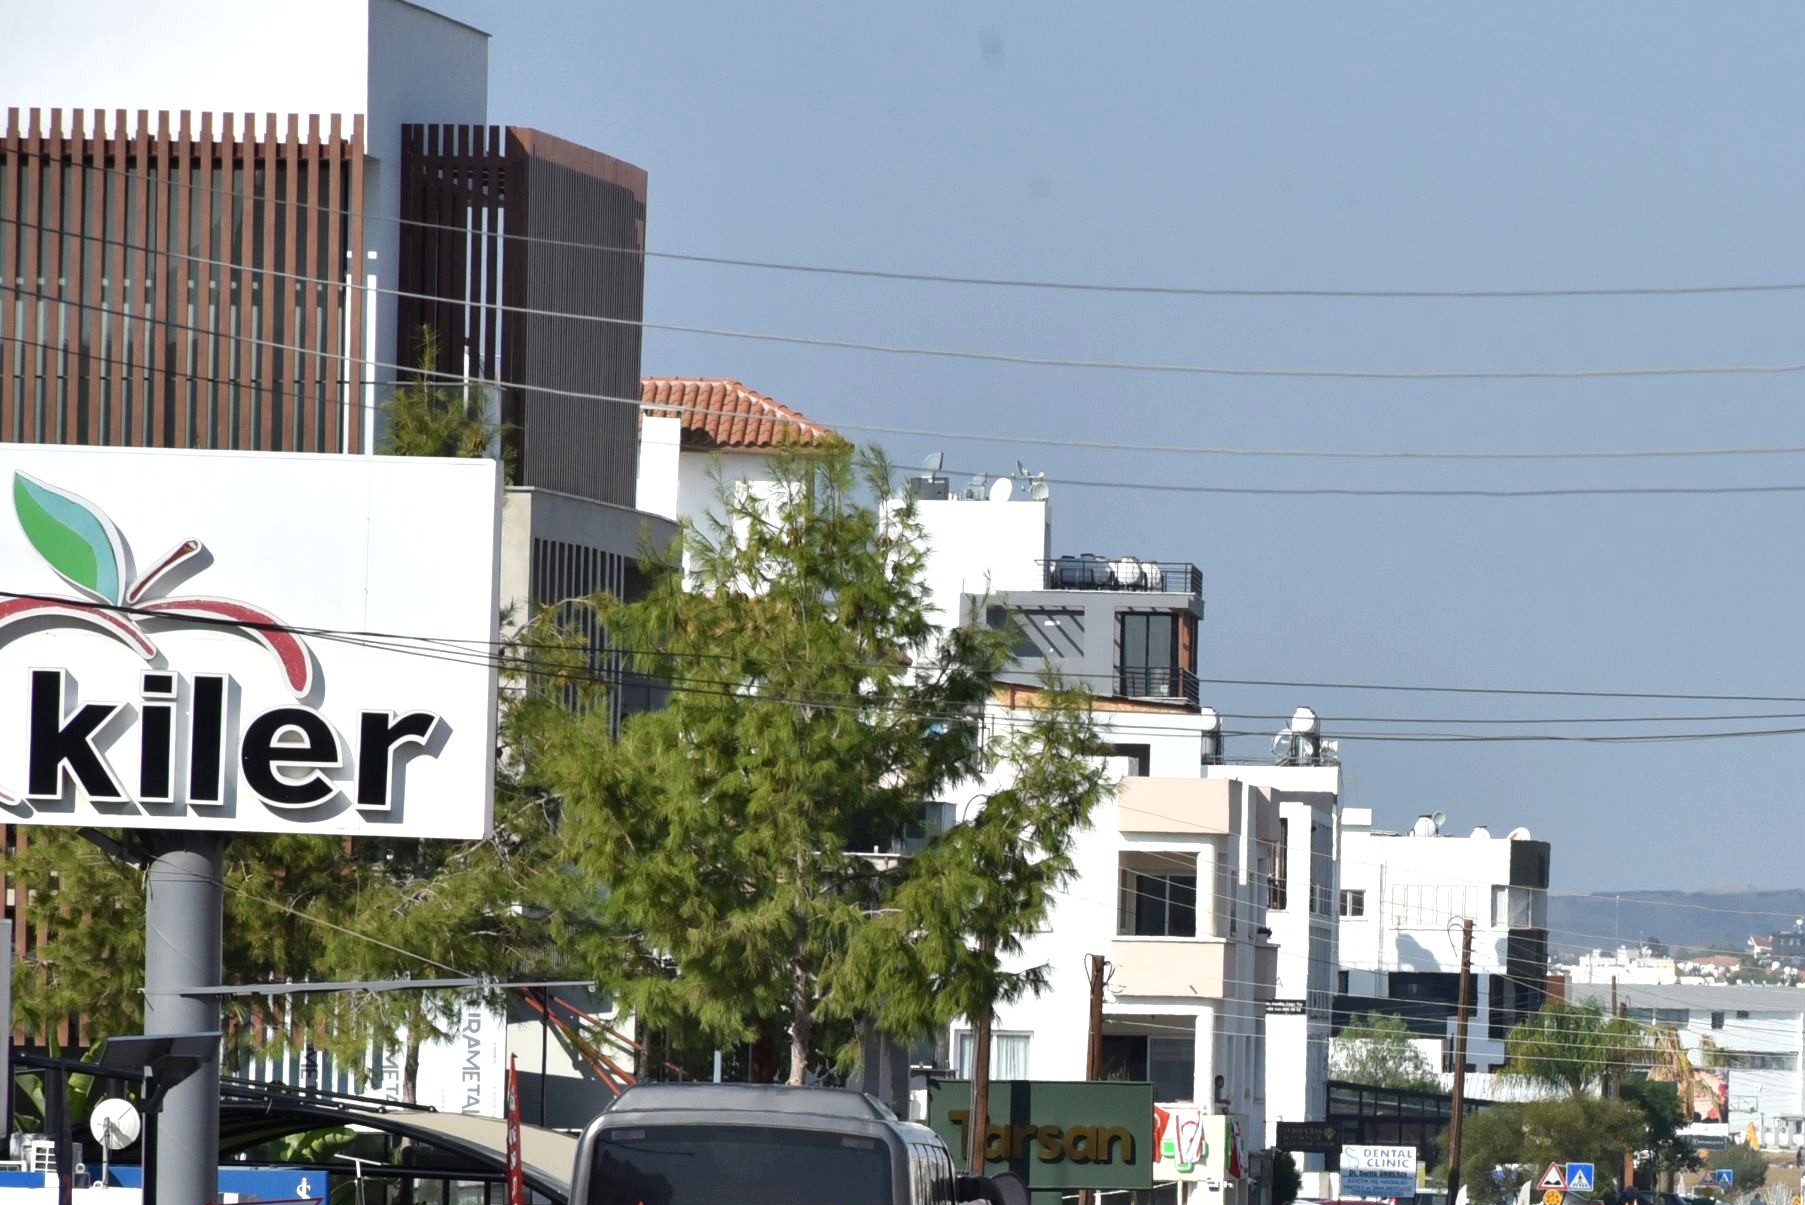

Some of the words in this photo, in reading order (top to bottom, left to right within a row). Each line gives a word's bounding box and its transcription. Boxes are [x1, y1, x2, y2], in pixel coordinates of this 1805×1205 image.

[27, 666, 442, 812] kiler
[948, 1109, 1135, 1163] Tarsan
[1363, 1148, 1412, 1158] DENTAL
[1367, 1158, 1409, 1168] CLINIC
